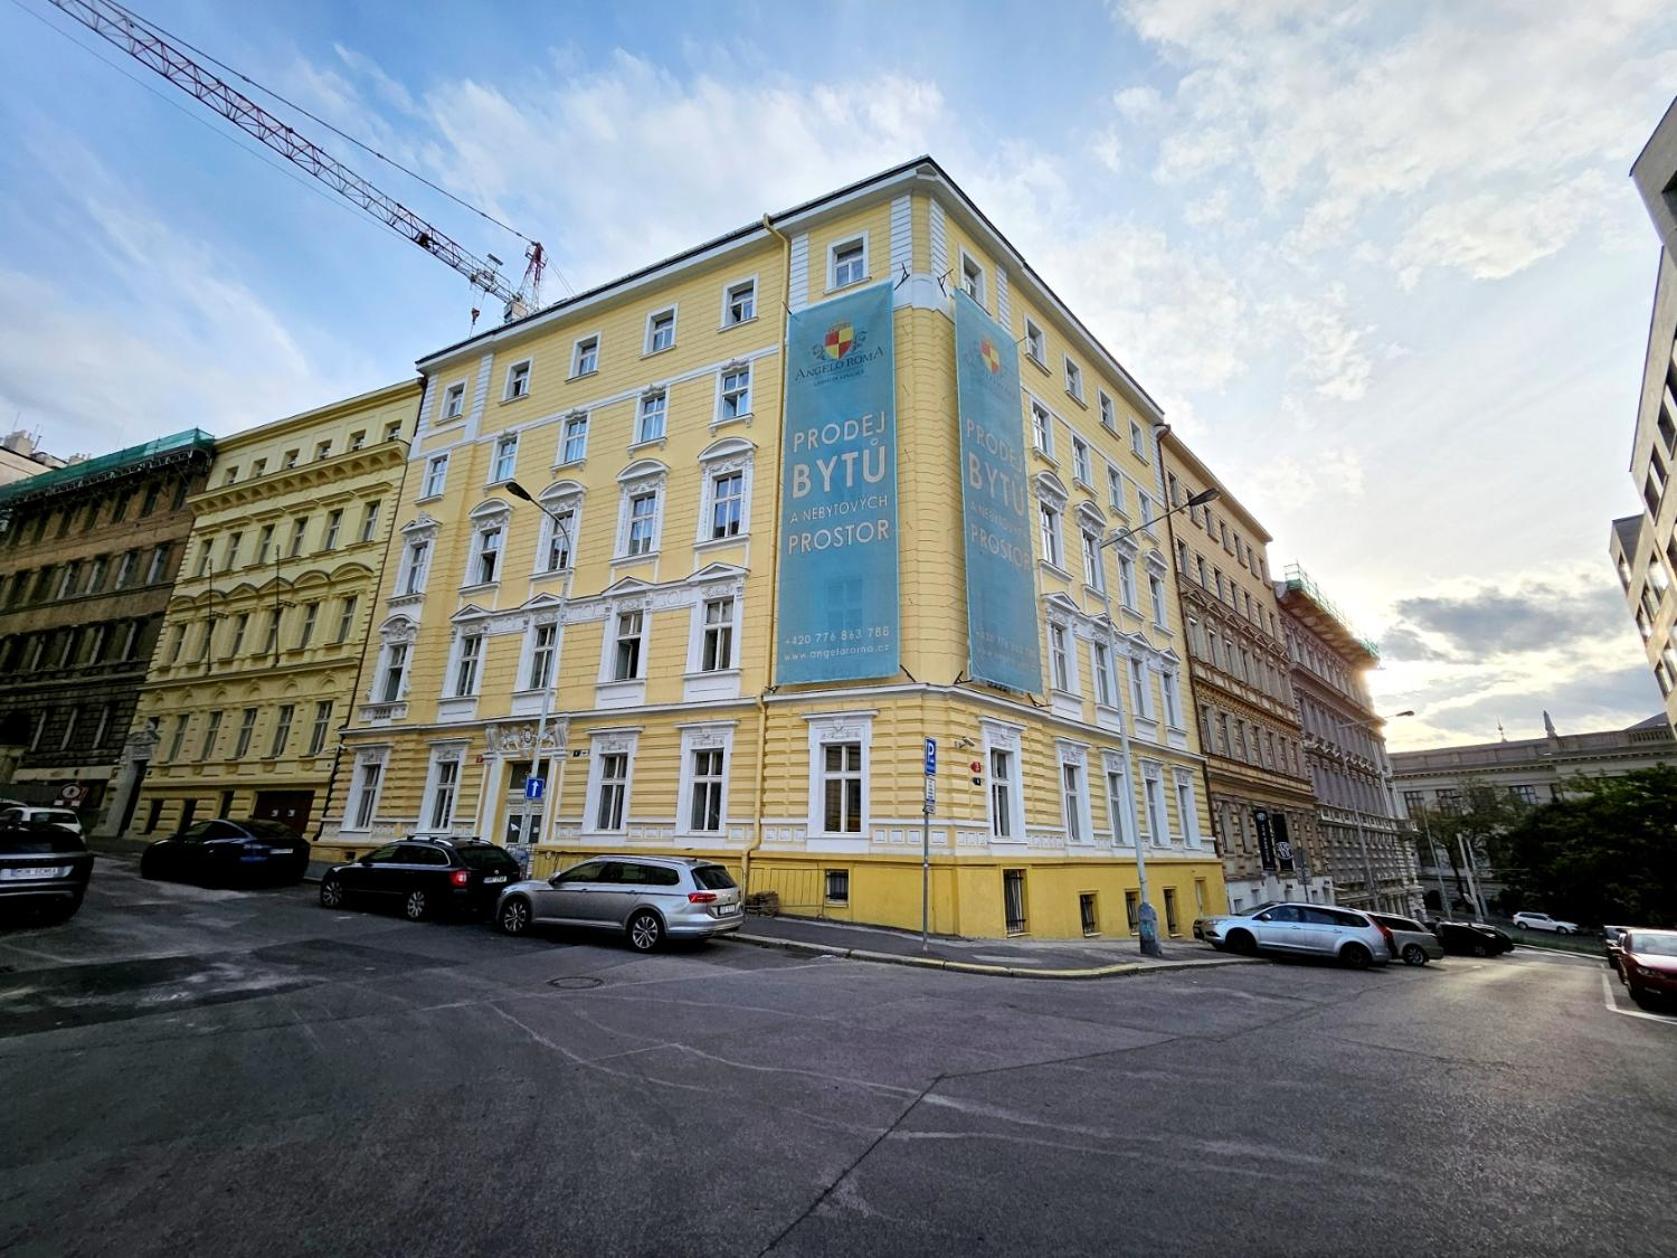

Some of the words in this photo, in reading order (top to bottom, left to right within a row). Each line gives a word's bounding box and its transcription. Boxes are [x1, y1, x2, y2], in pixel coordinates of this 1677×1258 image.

[794, 359, 844, 382] ANGELO
[846, 345, 885, 368] ROMA
[793, 411, 885, 453] PRODEJ
[966, 417, 1024, 473] PRODEJ
[792, 437, 886, 499] BYTŮ
[788, 518, 890, 555] PROSTOR
[789, 512, 798, 524] A
[970, 523, 1031, 571] PROSTOR
[927, 742, 935, 763] P
